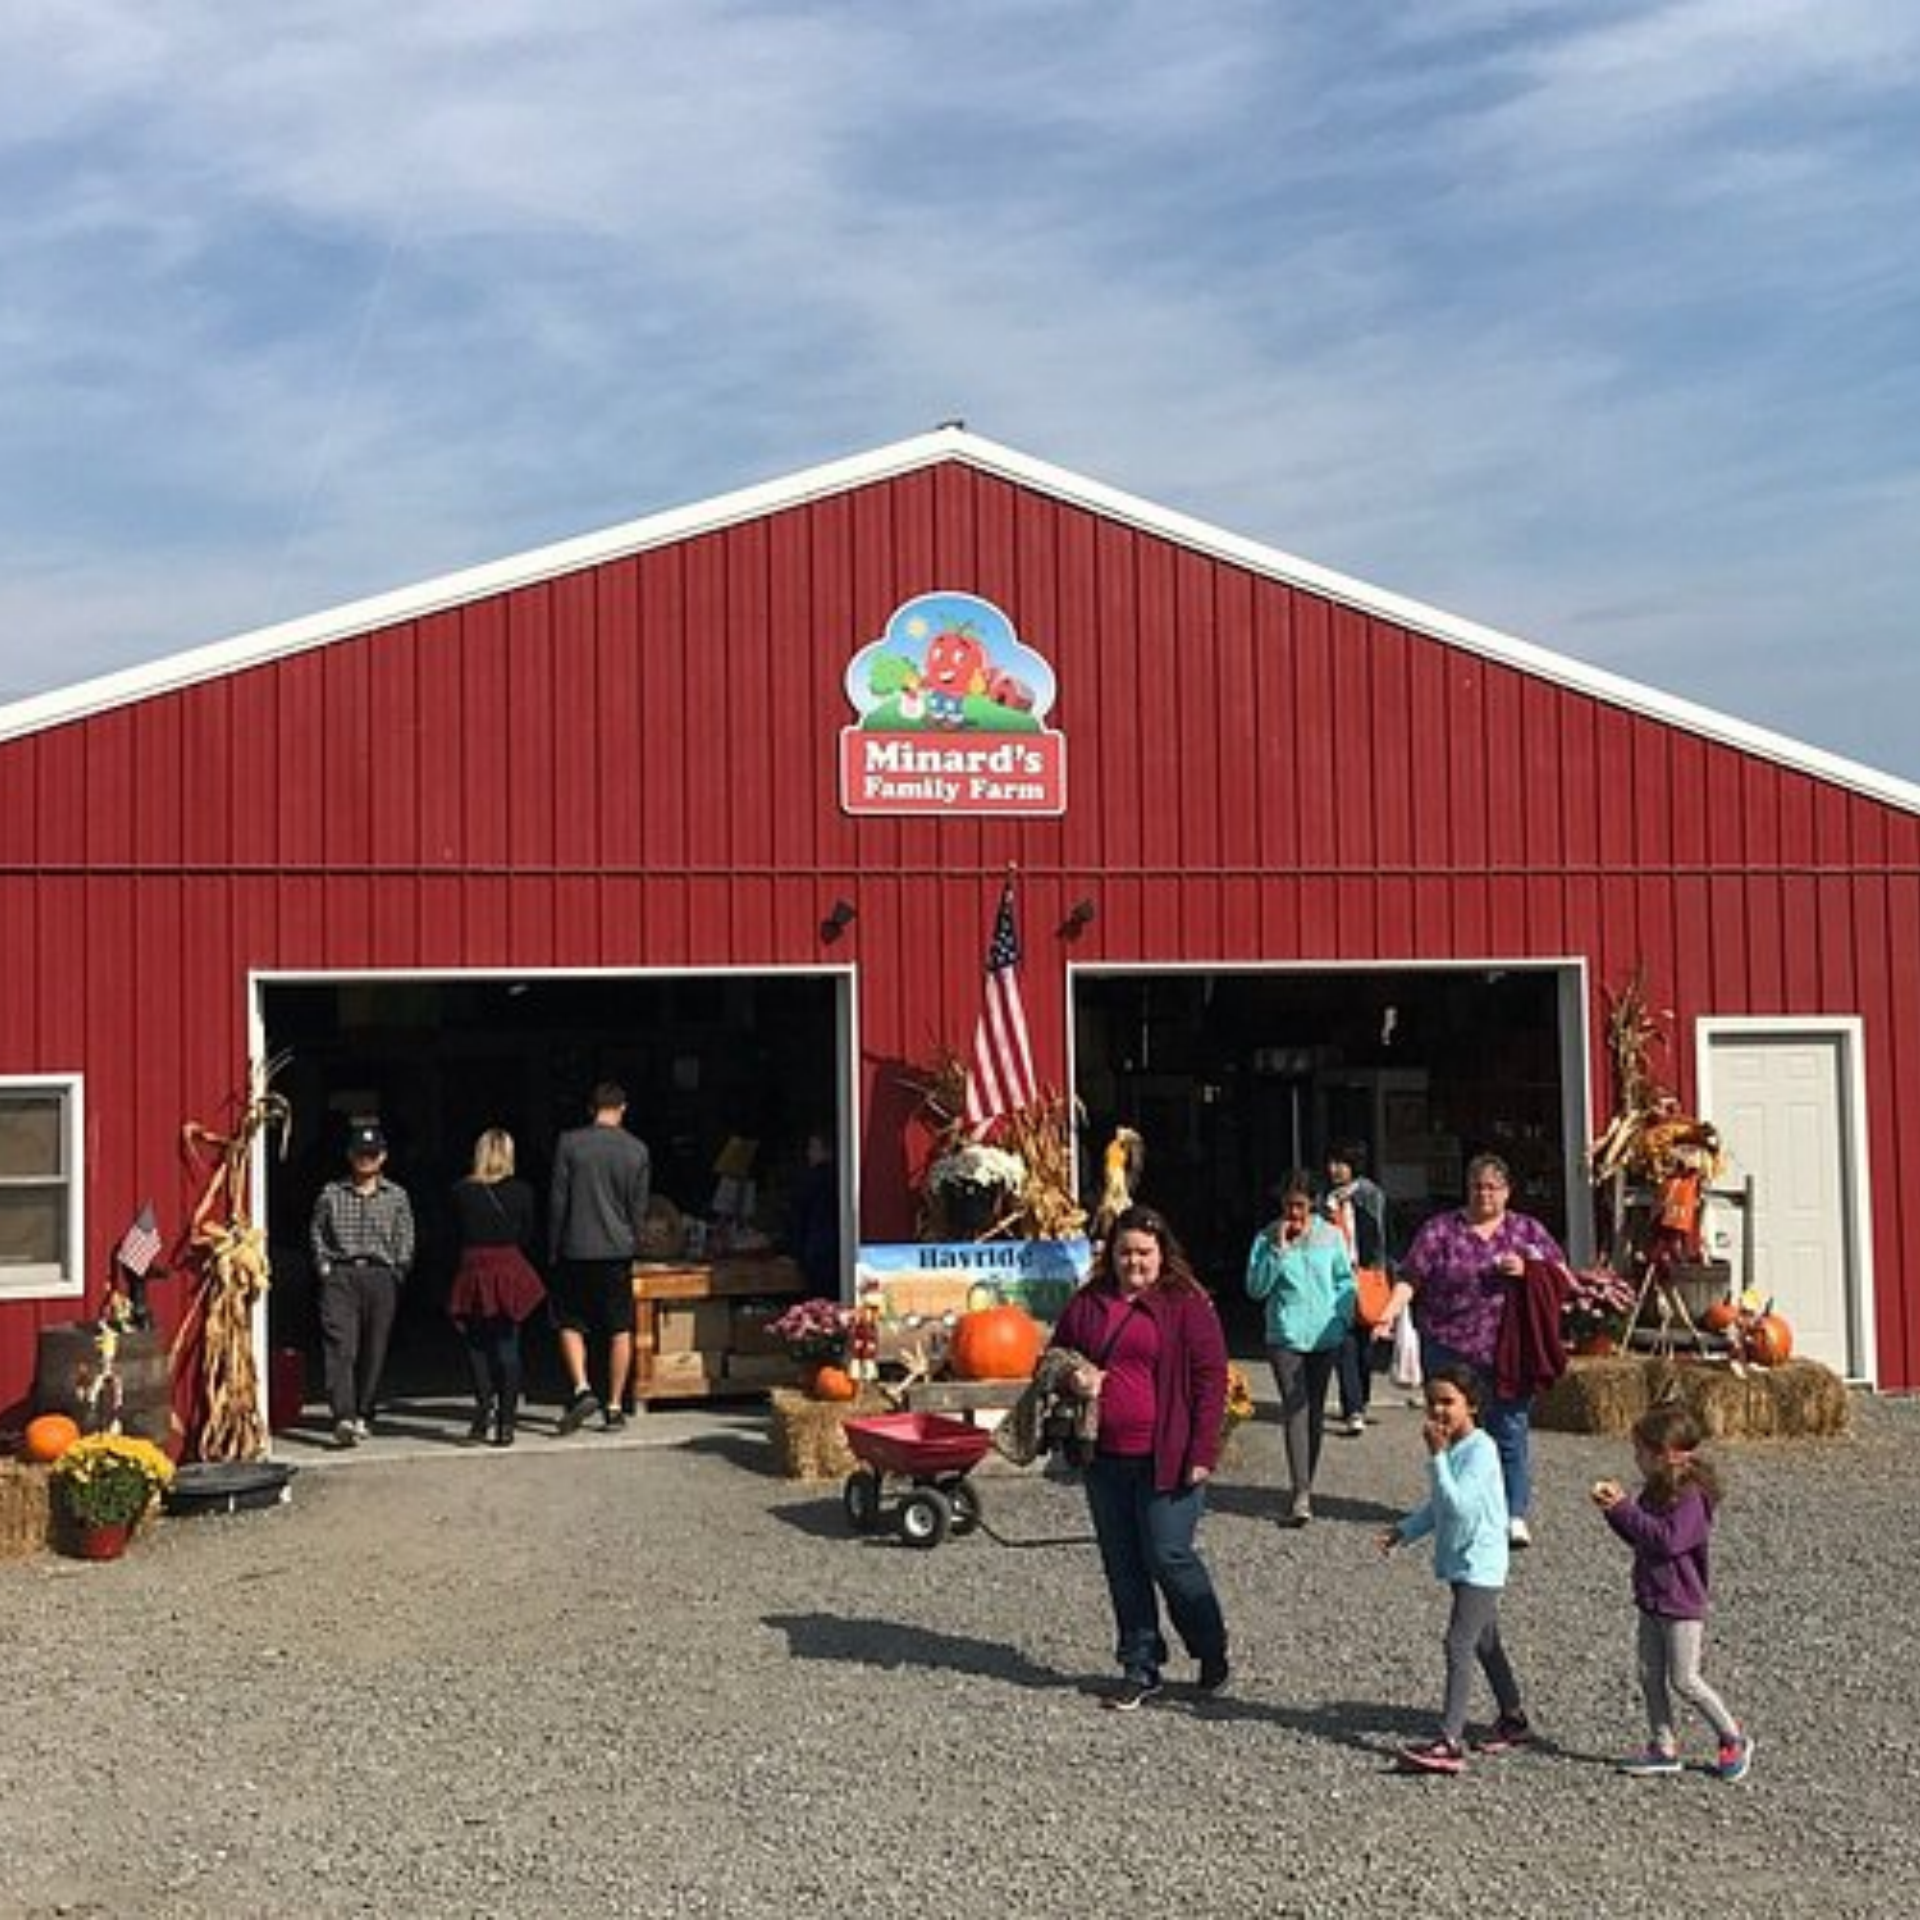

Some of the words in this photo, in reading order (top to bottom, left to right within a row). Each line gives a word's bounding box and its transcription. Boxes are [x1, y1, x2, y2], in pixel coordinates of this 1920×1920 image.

[864, 740, 1043, 774] Minard's
[864, 775, 960, 804] Family
[969, 777, 1046, 800] Farm
[918, 1246, 1034, 1271] Hayride
